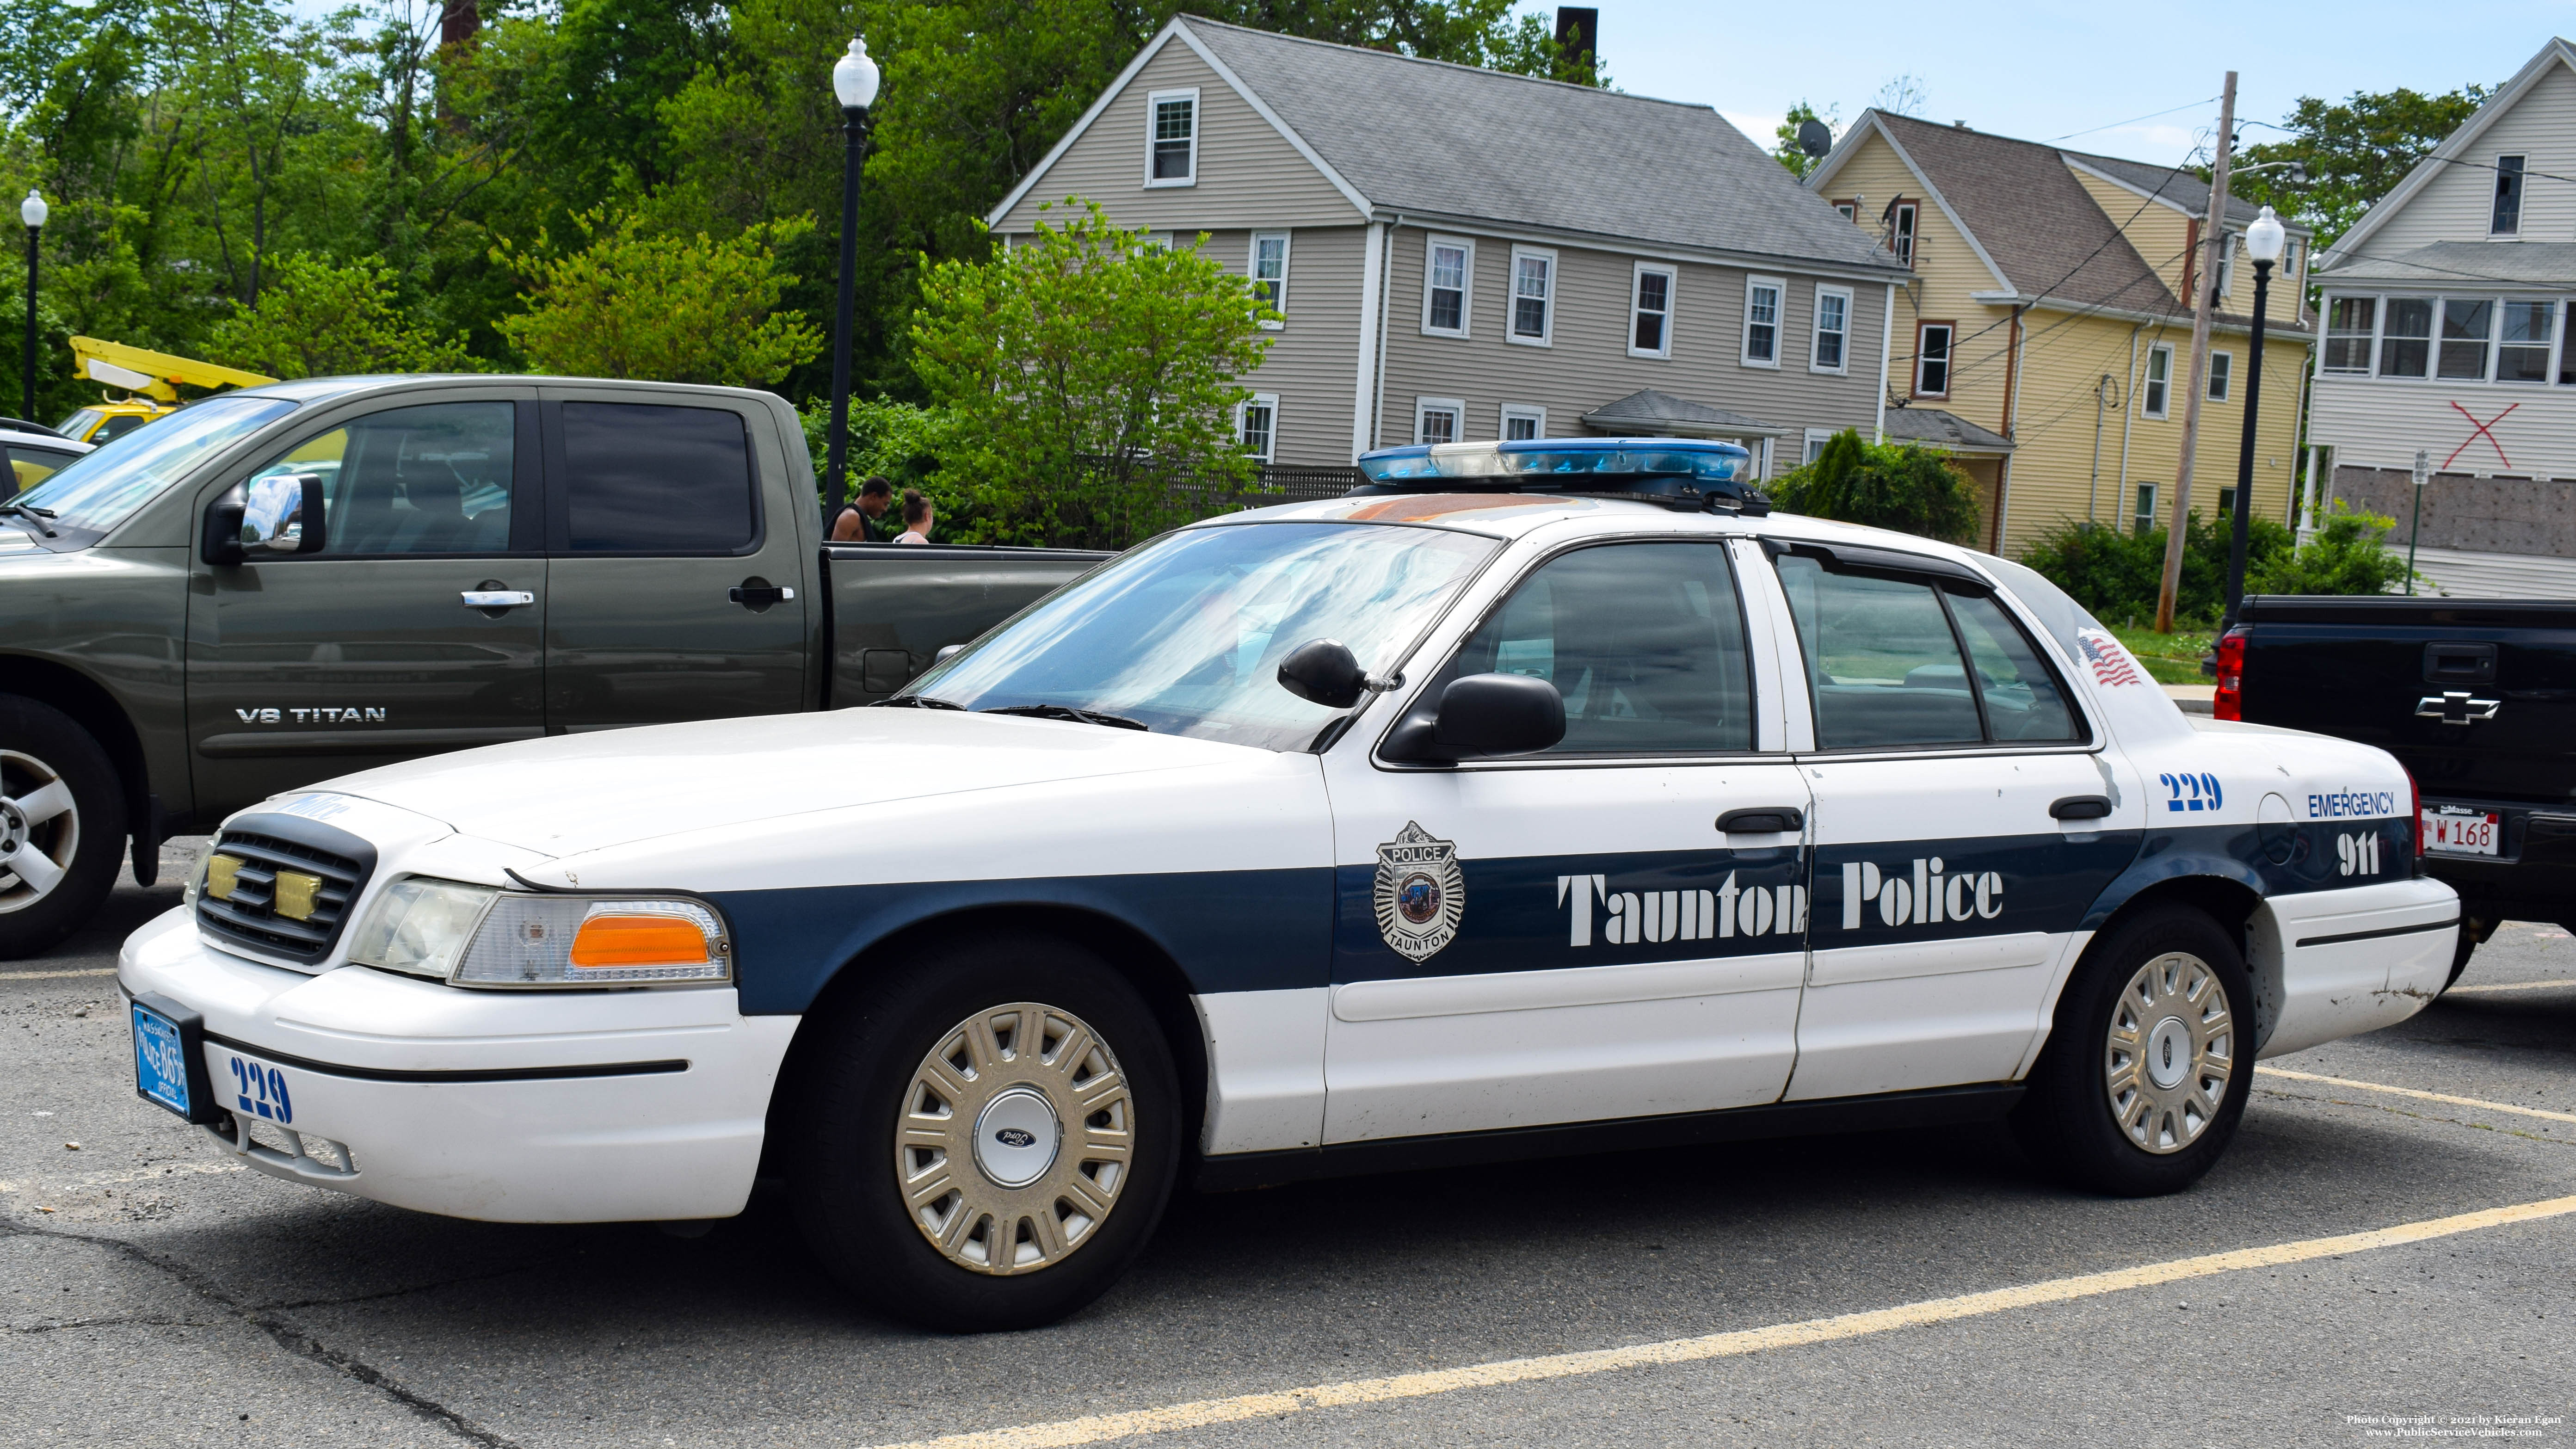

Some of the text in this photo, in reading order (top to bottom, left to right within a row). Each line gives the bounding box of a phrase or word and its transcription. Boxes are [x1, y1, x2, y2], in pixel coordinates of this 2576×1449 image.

[235, 707, 385, 724] V8 TITAN
[2160, 772, 2223, 812] 229
[2308, 791, 2395, 818] EMERGENCY
[2437, 819, 2490, 846] W 168
[1392, 846, 1442, 863] POLICE
[2337, 831, 2379, 876] 911
[1557, 857, 2003, 947] Taunton Police
[1389, 931, 1450, 951] TAUNTON
[137, 1024, 161, 1077] POLICE
[231, 1056, 293, 1124] 229
[1004, 1131, 1028, 1146] Ford
